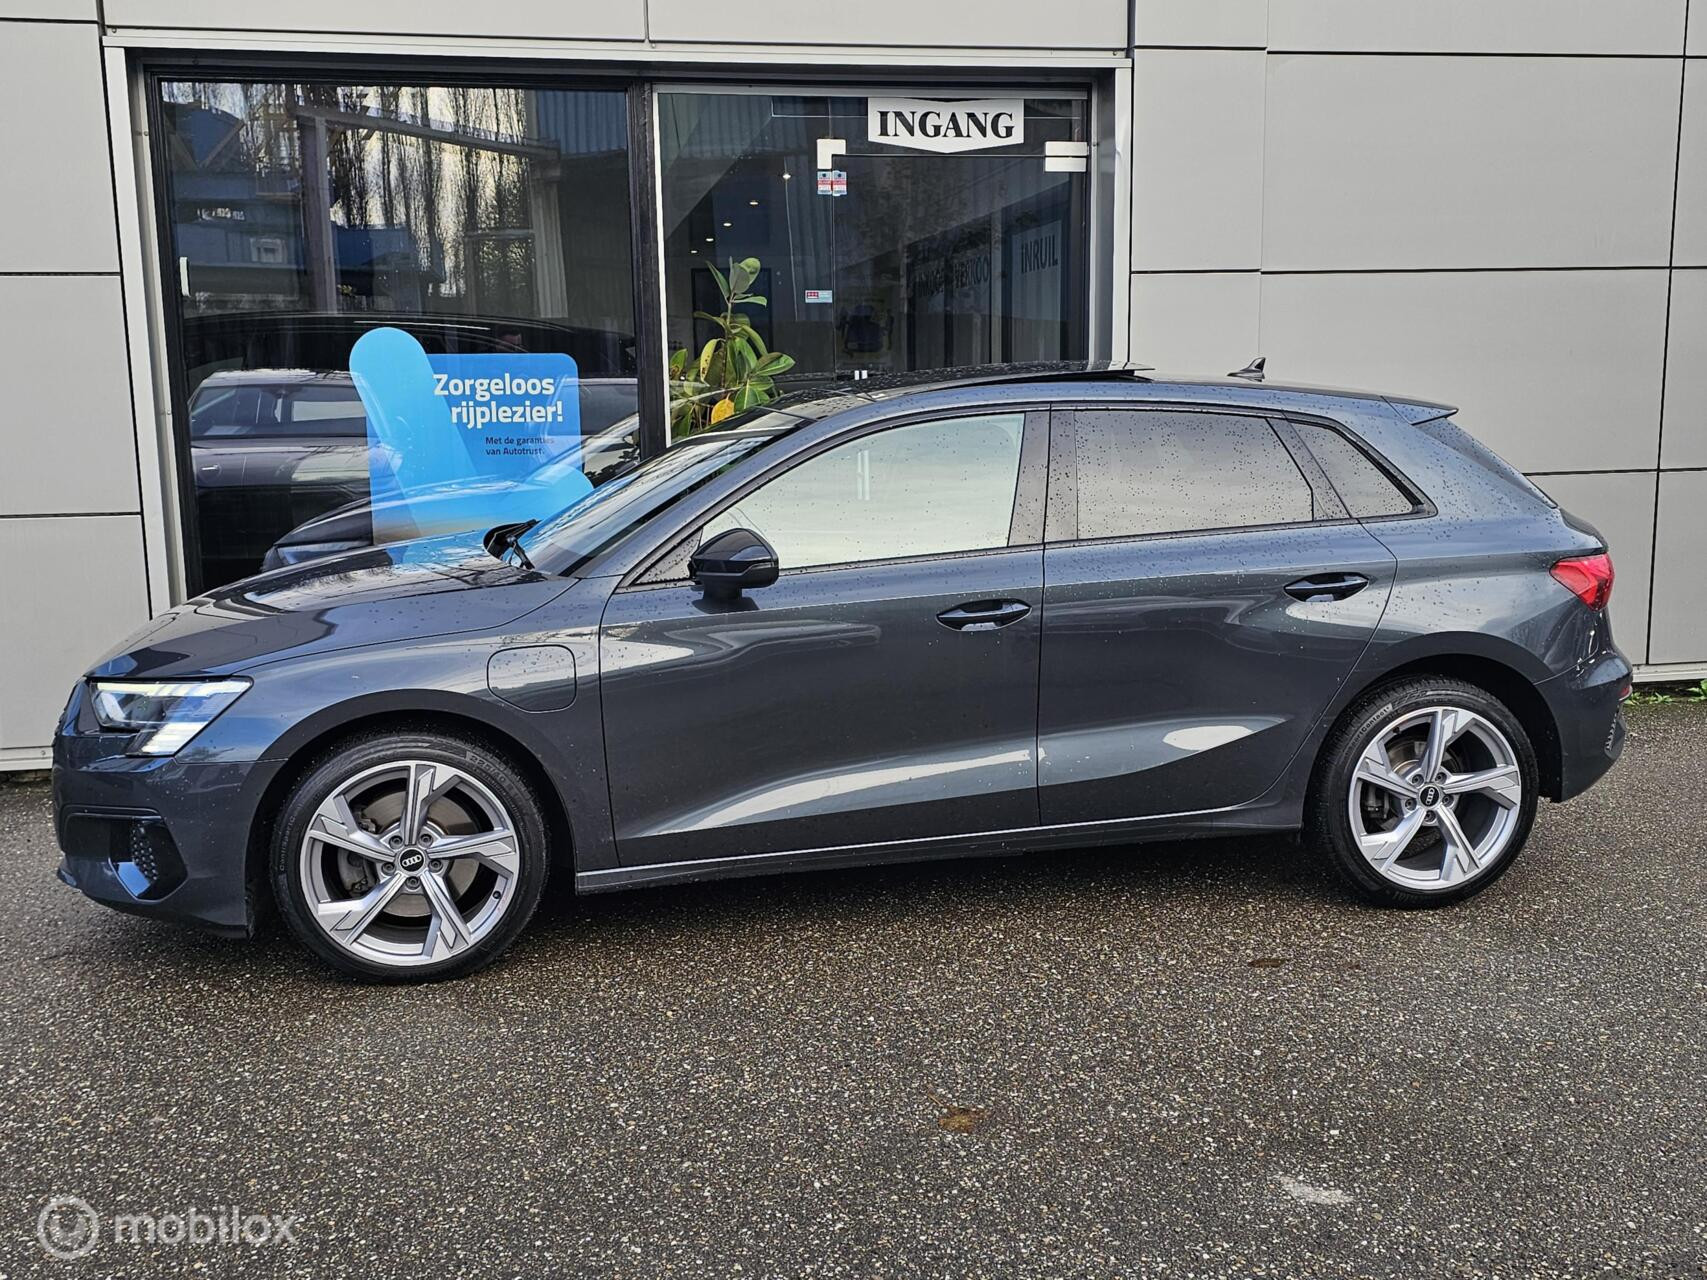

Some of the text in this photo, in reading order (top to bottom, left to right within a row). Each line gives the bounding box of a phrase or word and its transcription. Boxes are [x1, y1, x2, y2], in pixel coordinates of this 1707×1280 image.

[877, 110, 1015, 139] INGANG
[1021, 234, 1059, 274] INRUIL
[432, 373, 555, 402] Zorgeloos
[451, 400, 563, 429] rijplezier!
[485, 436, 502, 445] Met
[504, 436, 514, 445] de
